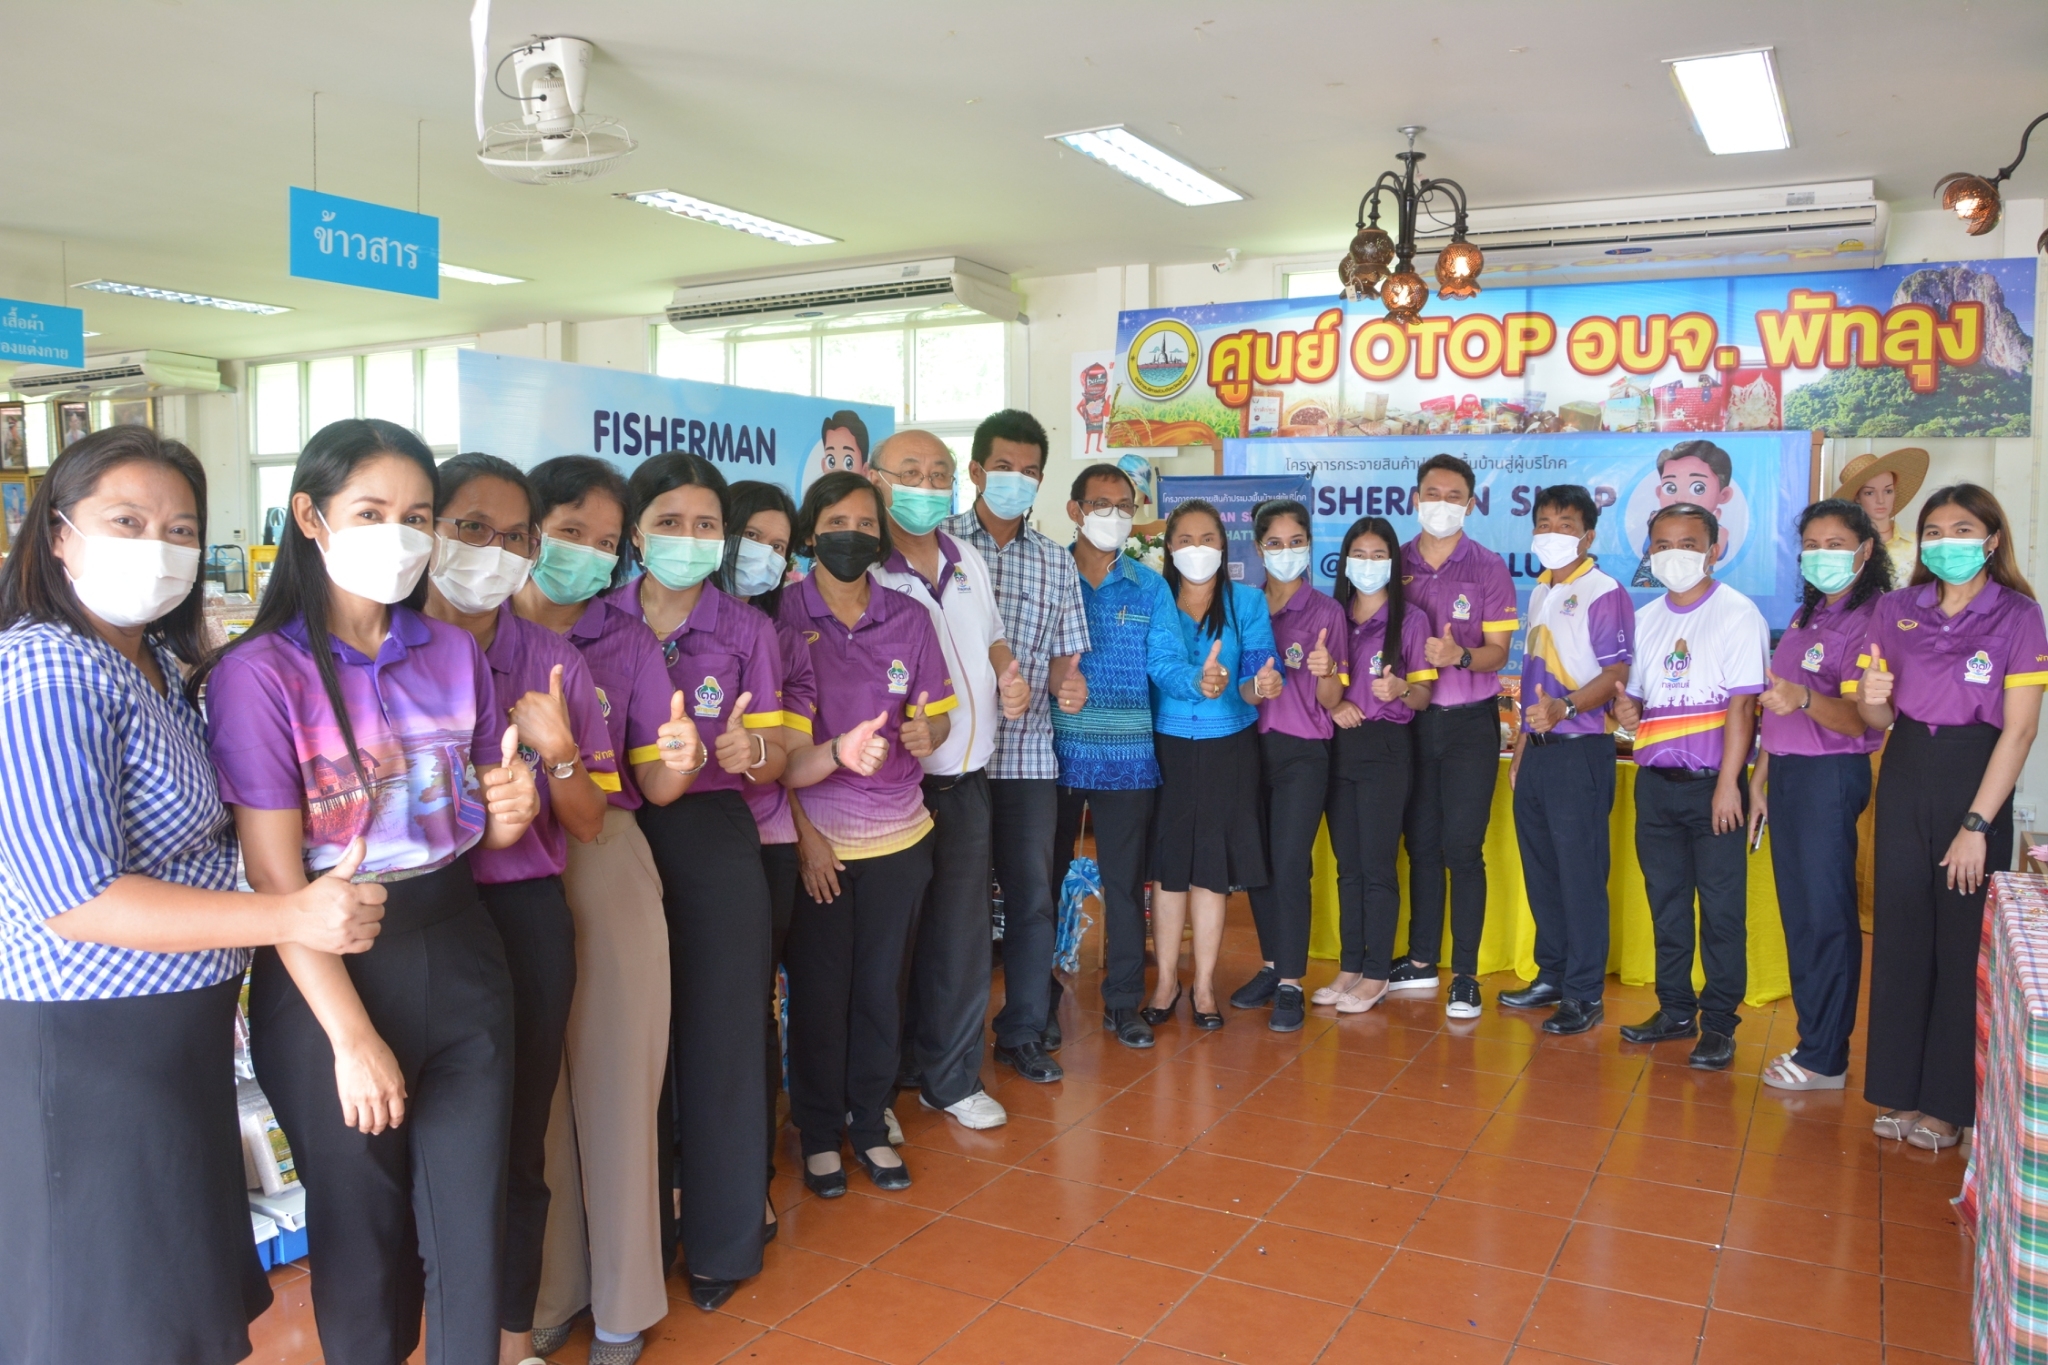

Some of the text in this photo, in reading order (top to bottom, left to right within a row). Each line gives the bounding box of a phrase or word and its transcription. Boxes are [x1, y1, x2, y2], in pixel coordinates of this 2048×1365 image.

[313, 209, 419, 270] ข้าวสาร
[2, 306, 44, 332] เสื้อผ้า
[0, 339, 69, 360] องแต่งกาย
[1208, 288, 1984, 407] ศูนย์ OTOP อบจ. พัทลุง
[594, 409, 776, 467] FISHERMAN
[1511, 485, 1617, 517] SP
